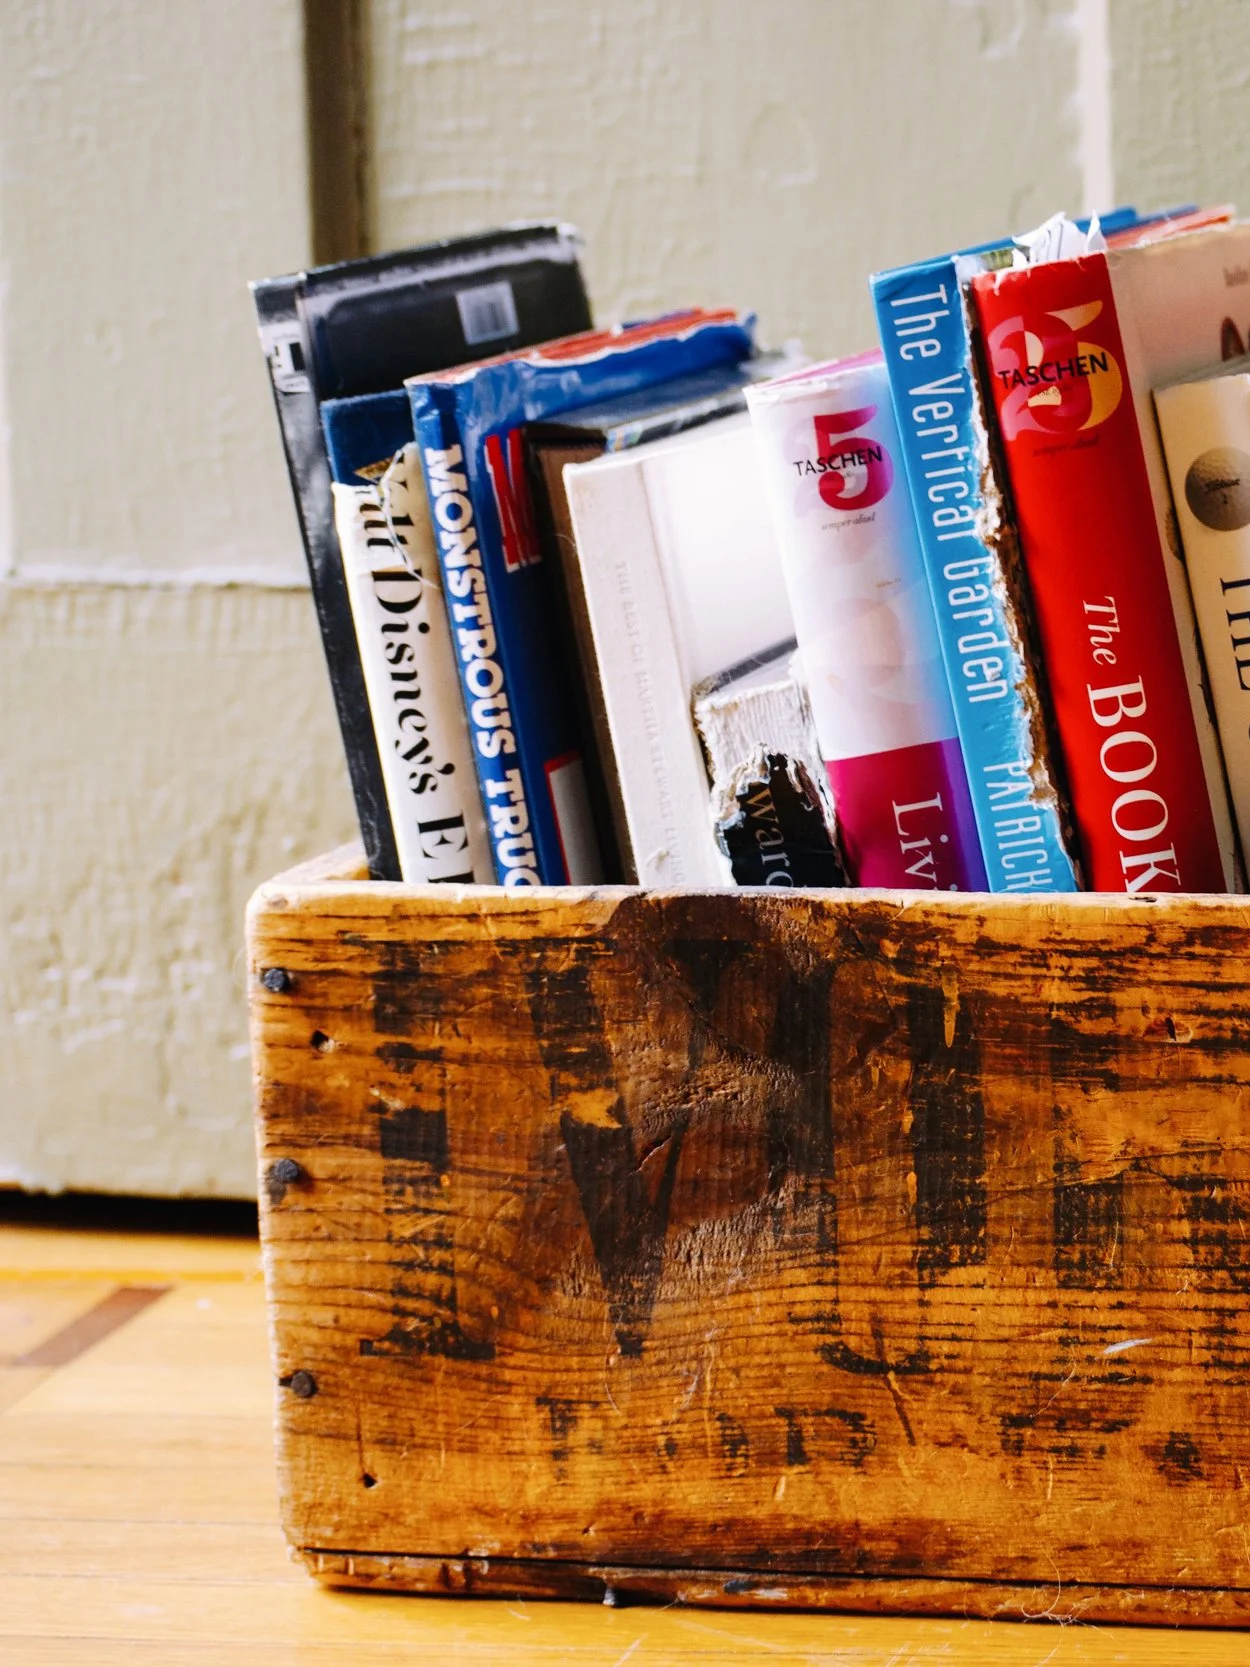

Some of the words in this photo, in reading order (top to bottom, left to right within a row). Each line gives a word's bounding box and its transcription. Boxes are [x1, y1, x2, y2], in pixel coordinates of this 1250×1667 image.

[890, 283, 950, 361] The
[998, 351, 1109, 389] TASCHEN
[793, 446, 883, 477] TASCHEN
[908, 372, 979, 541] Vertical
[424, 445, 516, 758] MONSTROUS
[943, 555, 1010, 703] Garden
[1083, 596, 1121, 666] The
[371, 568, 455, 795] Disney's
[416, 809, 475, 884] E
[1087, 675, 1181, 893] BOOK
[892, 791, 958, 890] Liv
